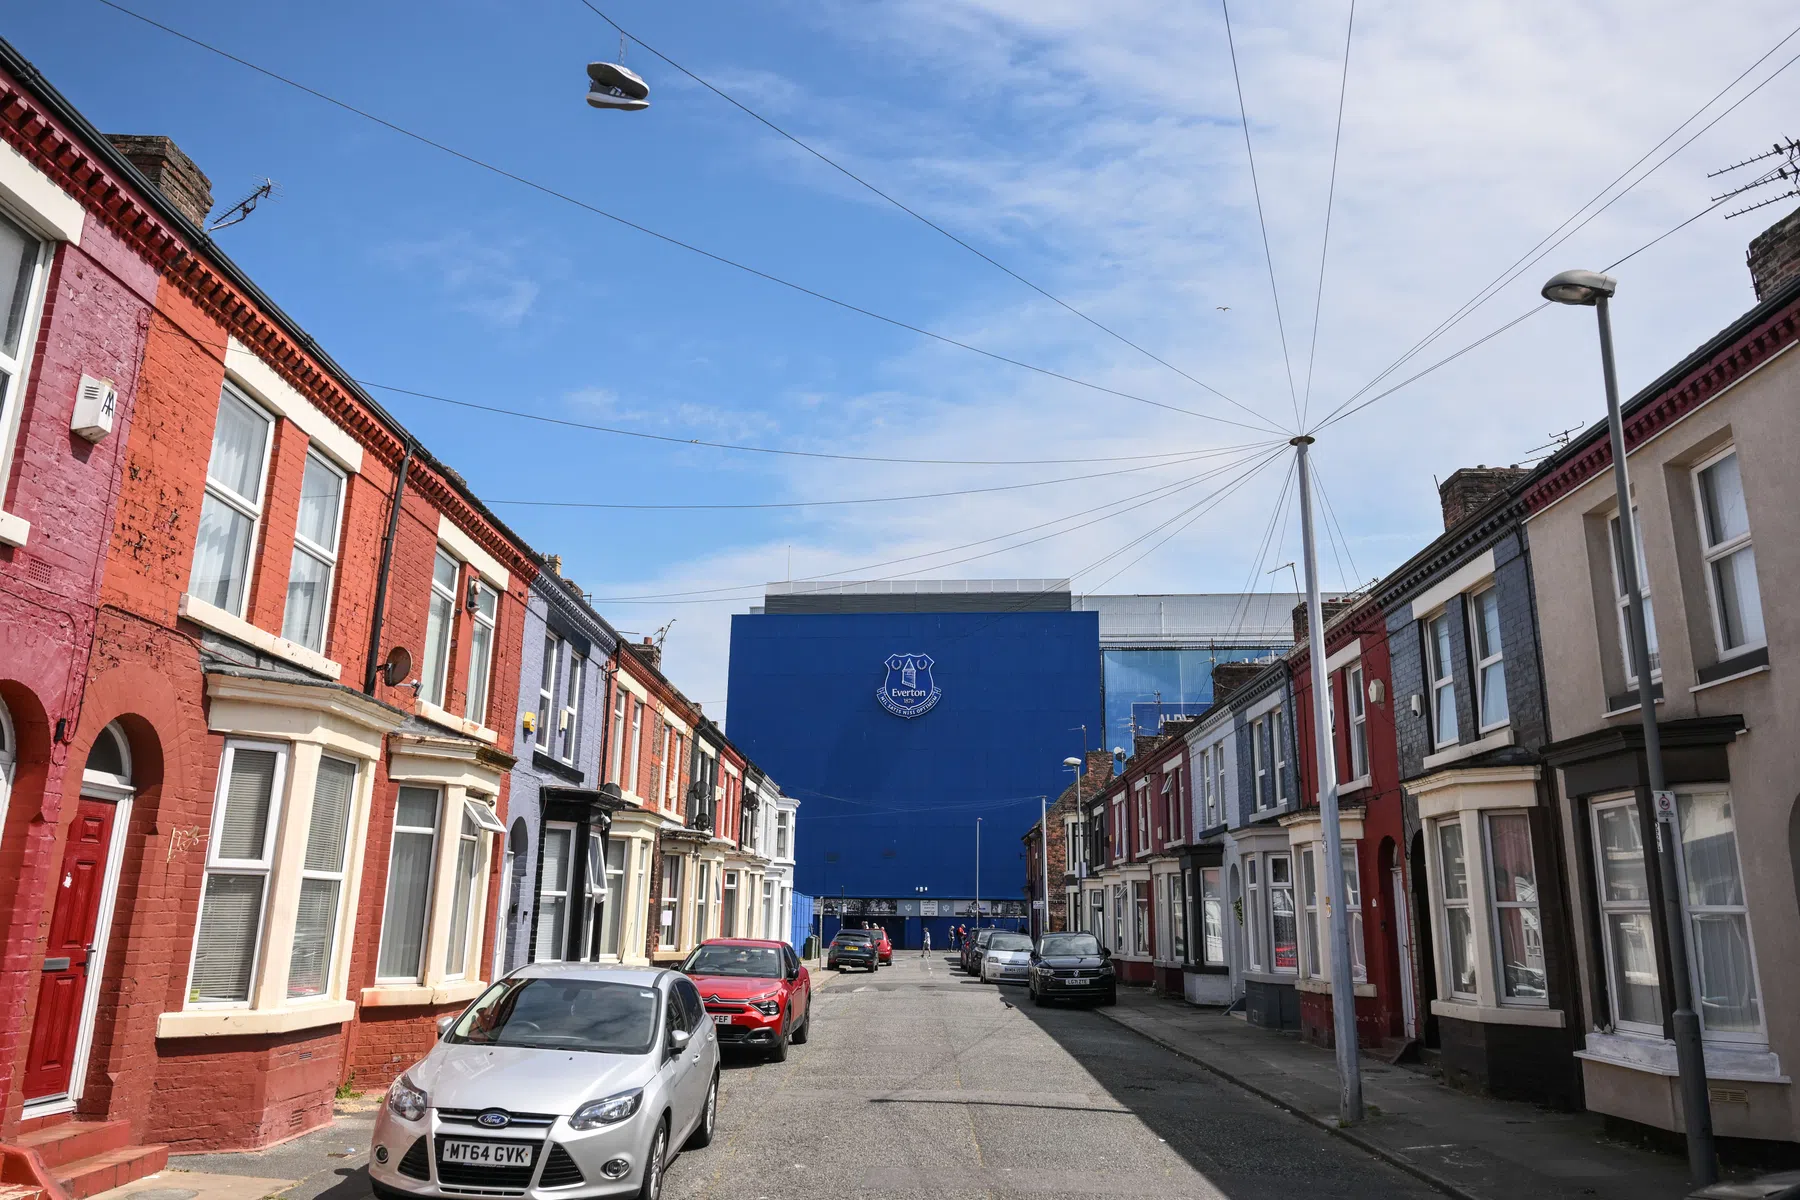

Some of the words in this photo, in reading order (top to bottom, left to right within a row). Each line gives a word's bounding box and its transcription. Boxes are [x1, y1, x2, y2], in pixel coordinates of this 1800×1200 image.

[892, 688, 926, 697] Everton
[888, 703, 901, 714] SATIS
[916, 695, 937, 714] OPTIMUM
[484, 1115, 501, 1123] Ford
[449, 1143, 490, 1161] MT64
[494, 1146, 526, 1163] GVK
